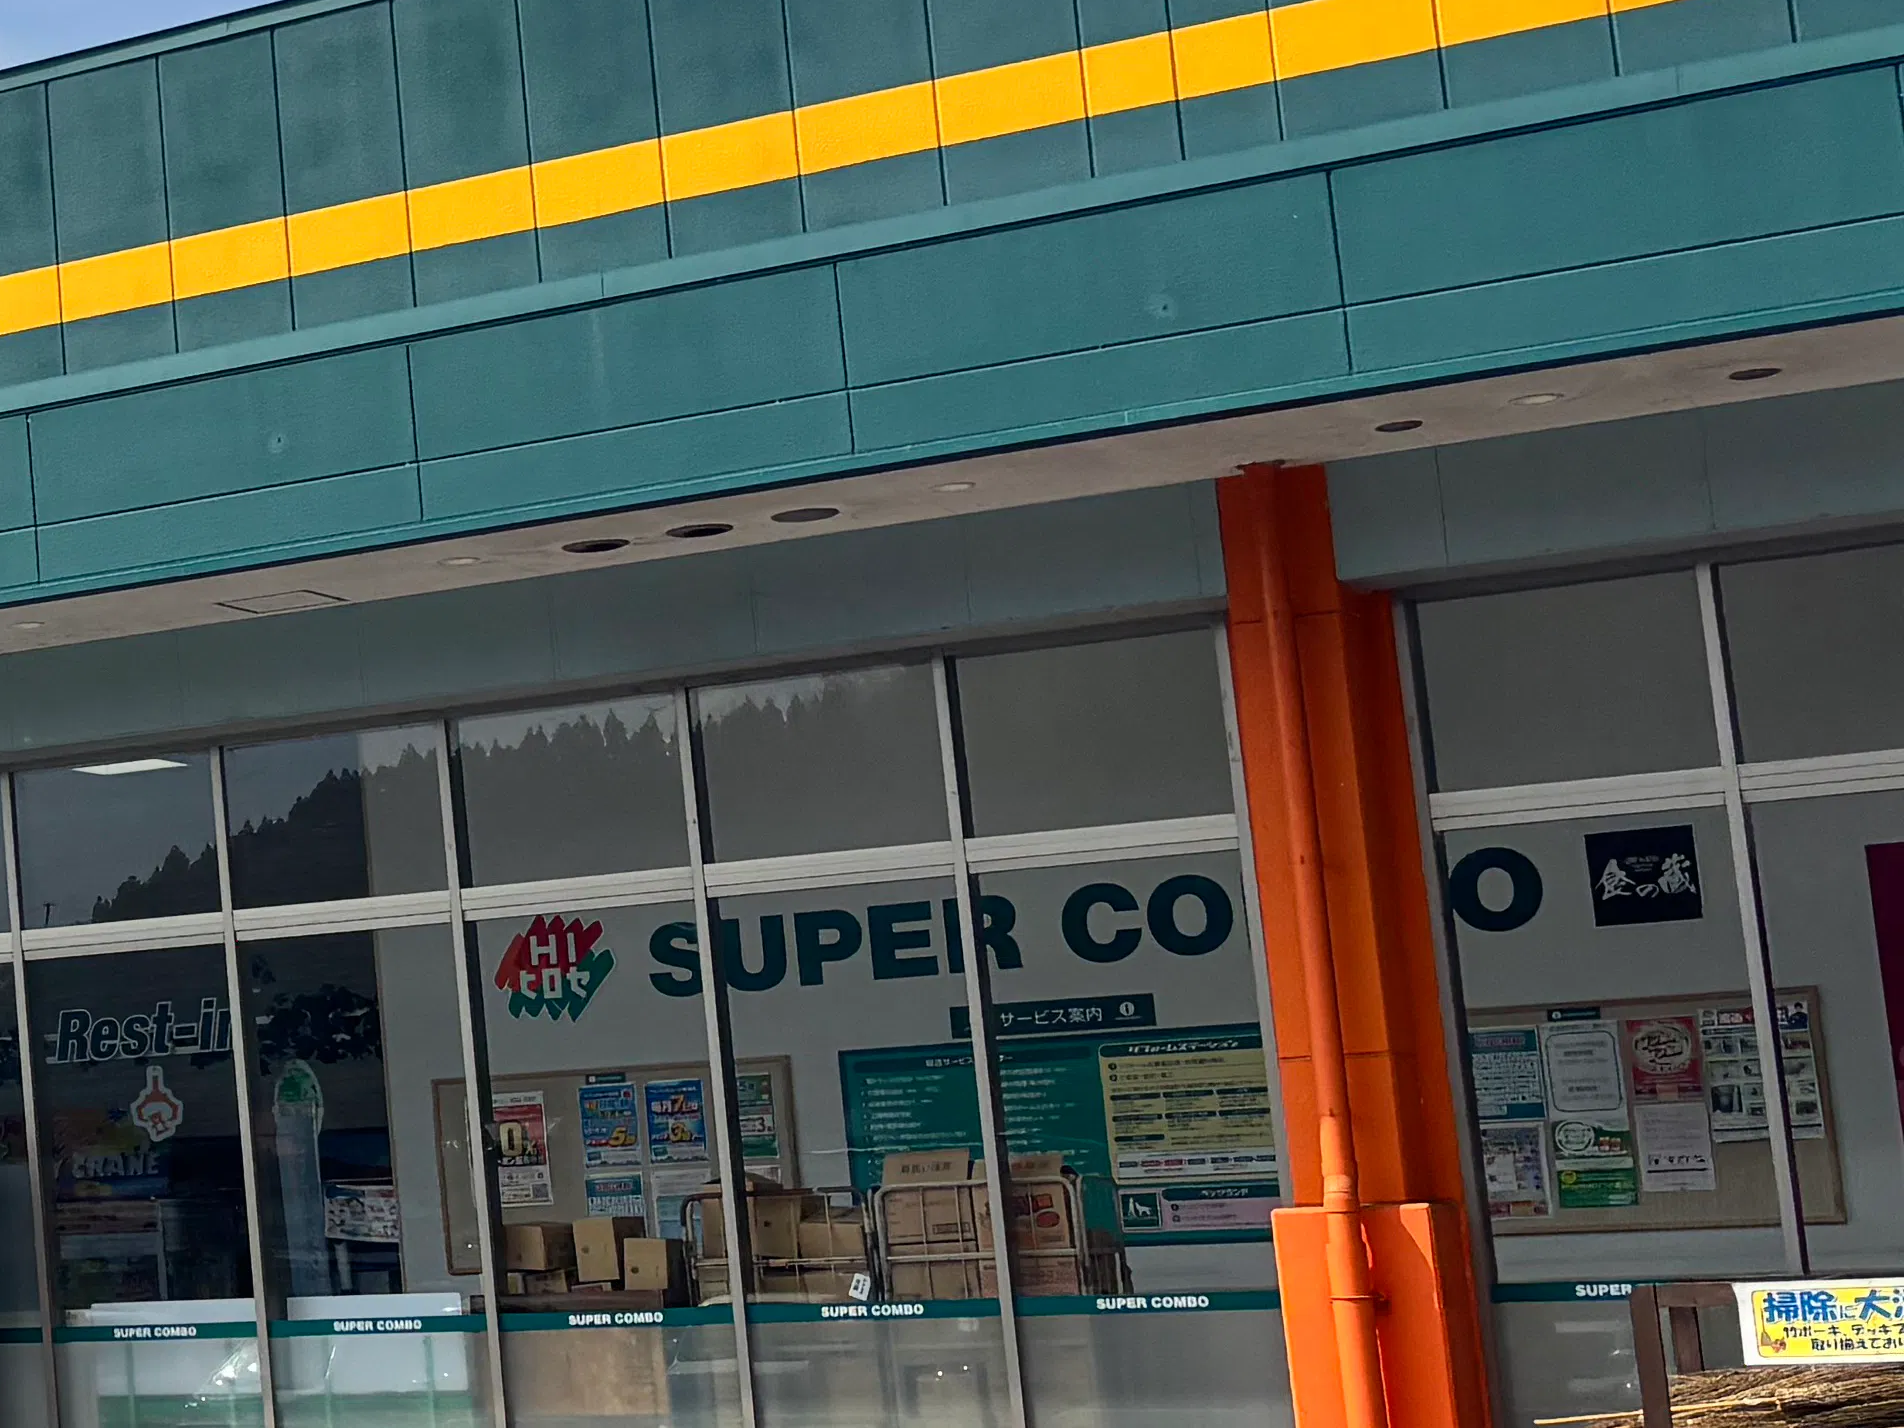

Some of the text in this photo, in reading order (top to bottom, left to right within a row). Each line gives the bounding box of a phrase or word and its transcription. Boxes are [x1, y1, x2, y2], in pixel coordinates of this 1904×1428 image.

[648, 846, 1544, 998] SUPER COO
[529, 932, 577, 966] HI
[1575, 1283, 1632, 1297] SUPER
[1096, 1295, 1209, 1310] SUPER COMBO
[820, 1303, 924, 1318] SUPER COMBO
[333, 1319, 422, 1332] SUPER COMBO
[568, 1312, 664, 1326] SUPER COMBO
[113, 1326, 197, 1338] SUPER COMBO
